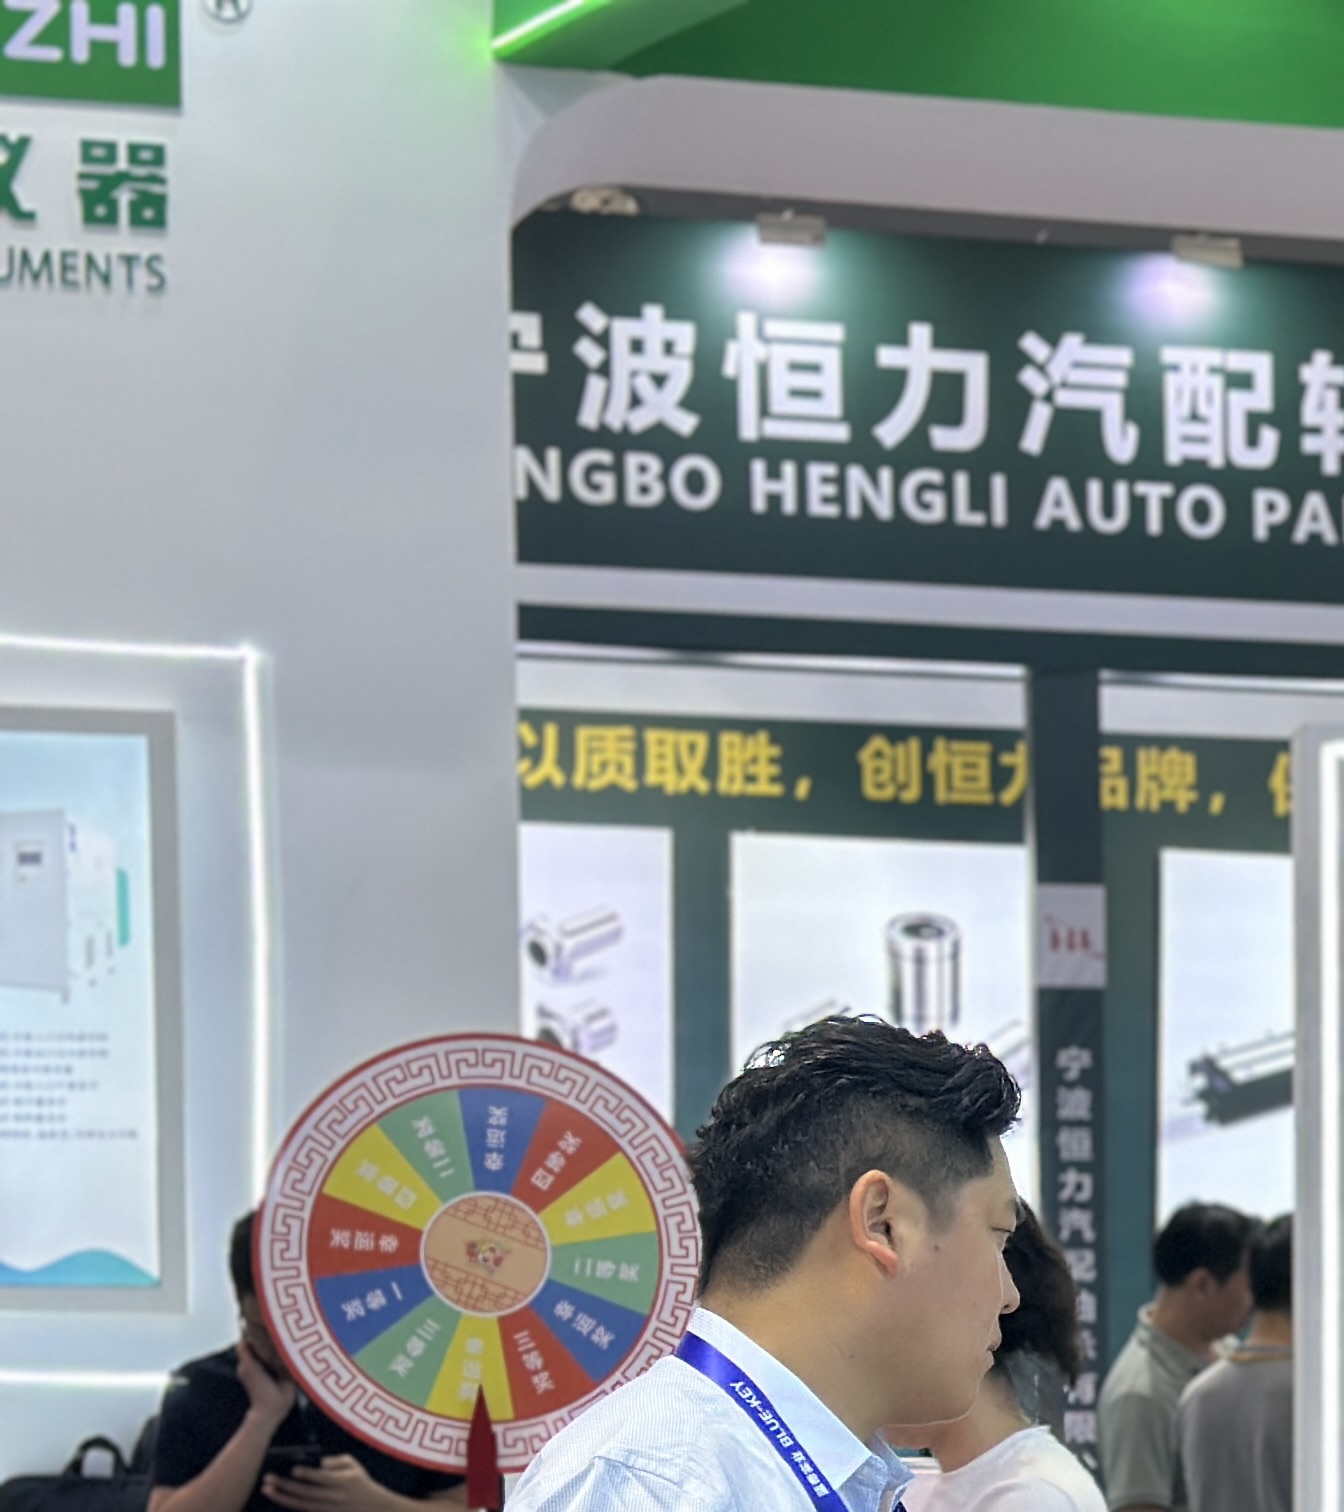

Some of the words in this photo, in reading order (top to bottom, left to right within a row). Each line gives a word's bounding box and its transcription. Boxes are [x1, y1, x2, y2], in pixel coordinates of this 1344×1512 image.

[750, 459, 1007, 528] HENGLI
[1034, 477, 1226, 540] AUTO
[411, 1115, 455, 1179] 二等奖
[483, 1105, 508, 1172] 幸运奖
[531, 1130, 584, 1192] 四等奖
[330, 1227, 399, 1253] 幸运奖
[574, 1257, 641, 1284] 二等奖
[1055, 1045, 1098, 1470] 宁波恒力汽配有限
[339, 1281, 404, 1323] 一等奖
[553, 1300, 617, 1351] 幸运奖
[388, 1318, 442, 1378] 三等奖
[513, 1330, 555, 1394] 三等奖
[729, 1381, 795, 1448] BLUE-KEY
